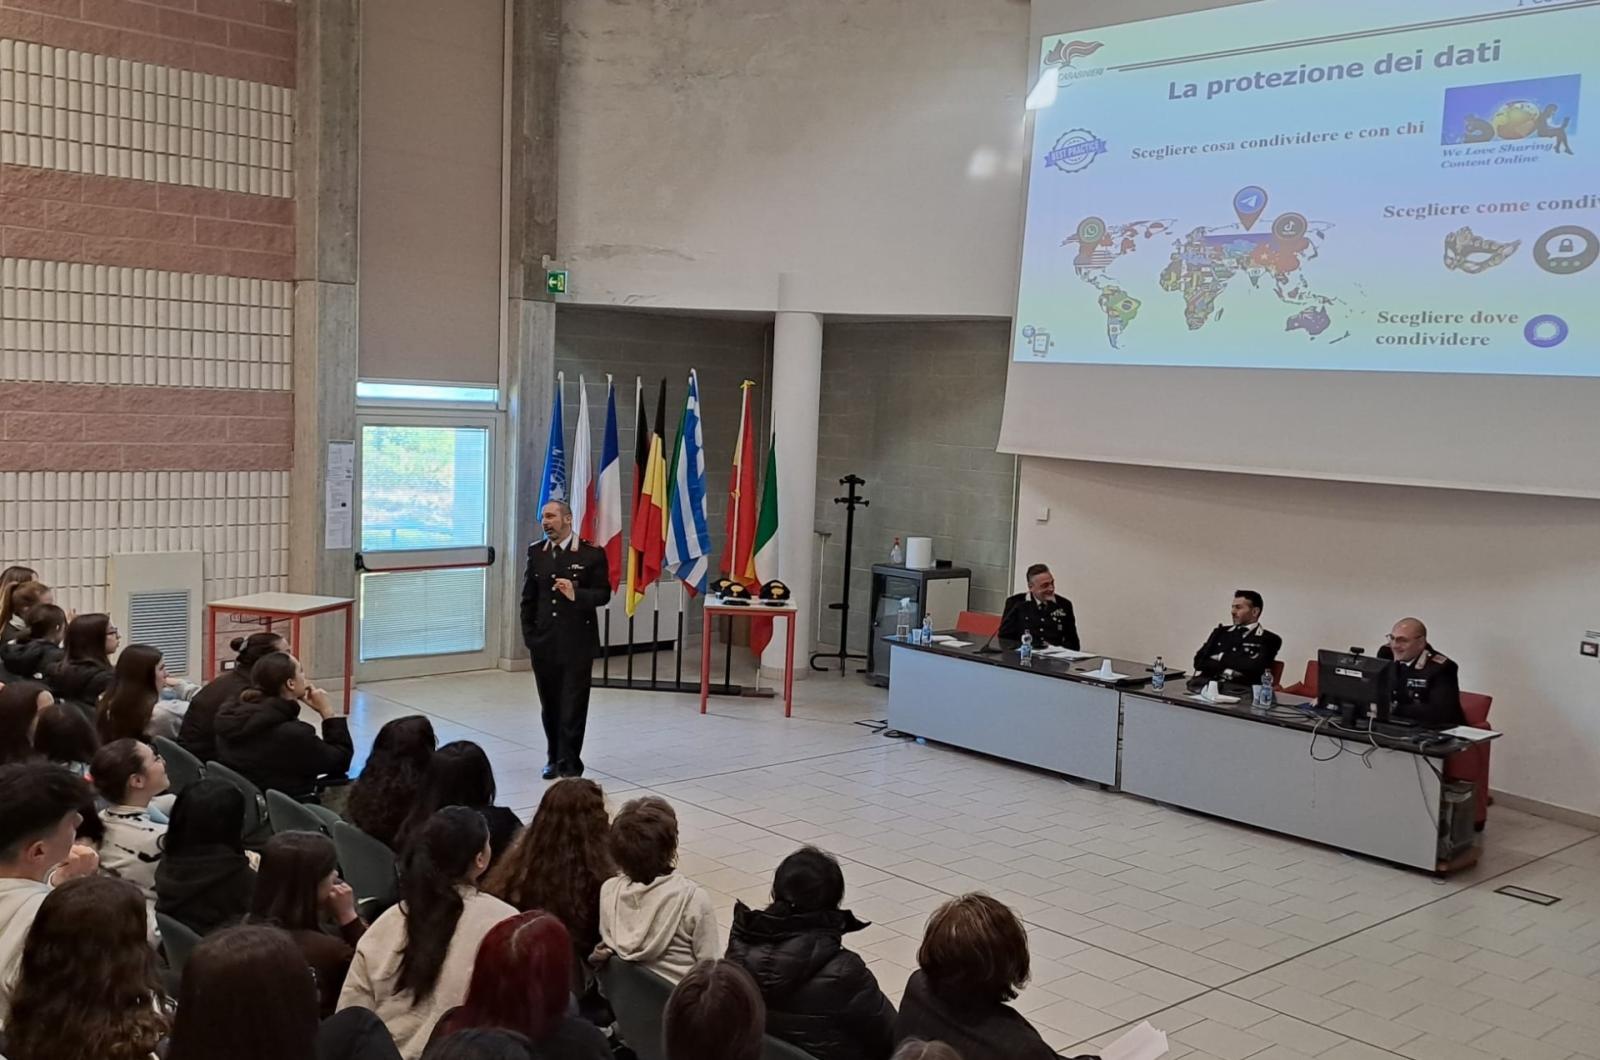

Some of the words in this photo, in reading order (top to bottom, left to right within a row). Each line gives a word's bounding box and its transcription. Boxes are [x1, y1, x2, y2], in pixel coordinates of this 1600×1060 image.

[1168, 81, 1198, 100] La
[1207, 61, 1364, 100] protezione
[1374, 49, 1423, 75] dei
[1433, 39, 1501, 68] dati
[1131, 144, 1198, 160] Scegliere
[1202, 141, 1235, 153] cosa
[1240, 131, 1339, 149] condividere
[1344, 130, 1354, 140] e
[1359, 126, 1390, 138] con
[1396, 120, 1425, 135] chi
[1443, 148, 1463, 158] We
[1465, 147, 1496, 156] Love
[1498, 142, 1553, 153] Sharing
[1440, 158, 1490, 168] Content
[1494, 155, 1539, 165] Online
[1383, 202, 1470, 220] Scegliere
[1476, 201, 1531, 214] come
[1536, 194, 1600, 210] condi
[1377, 310, 1464, 327] Scegliere
[1470, 310, 1519, 324] dove
[1375, 332, 1491, 346] condividere
